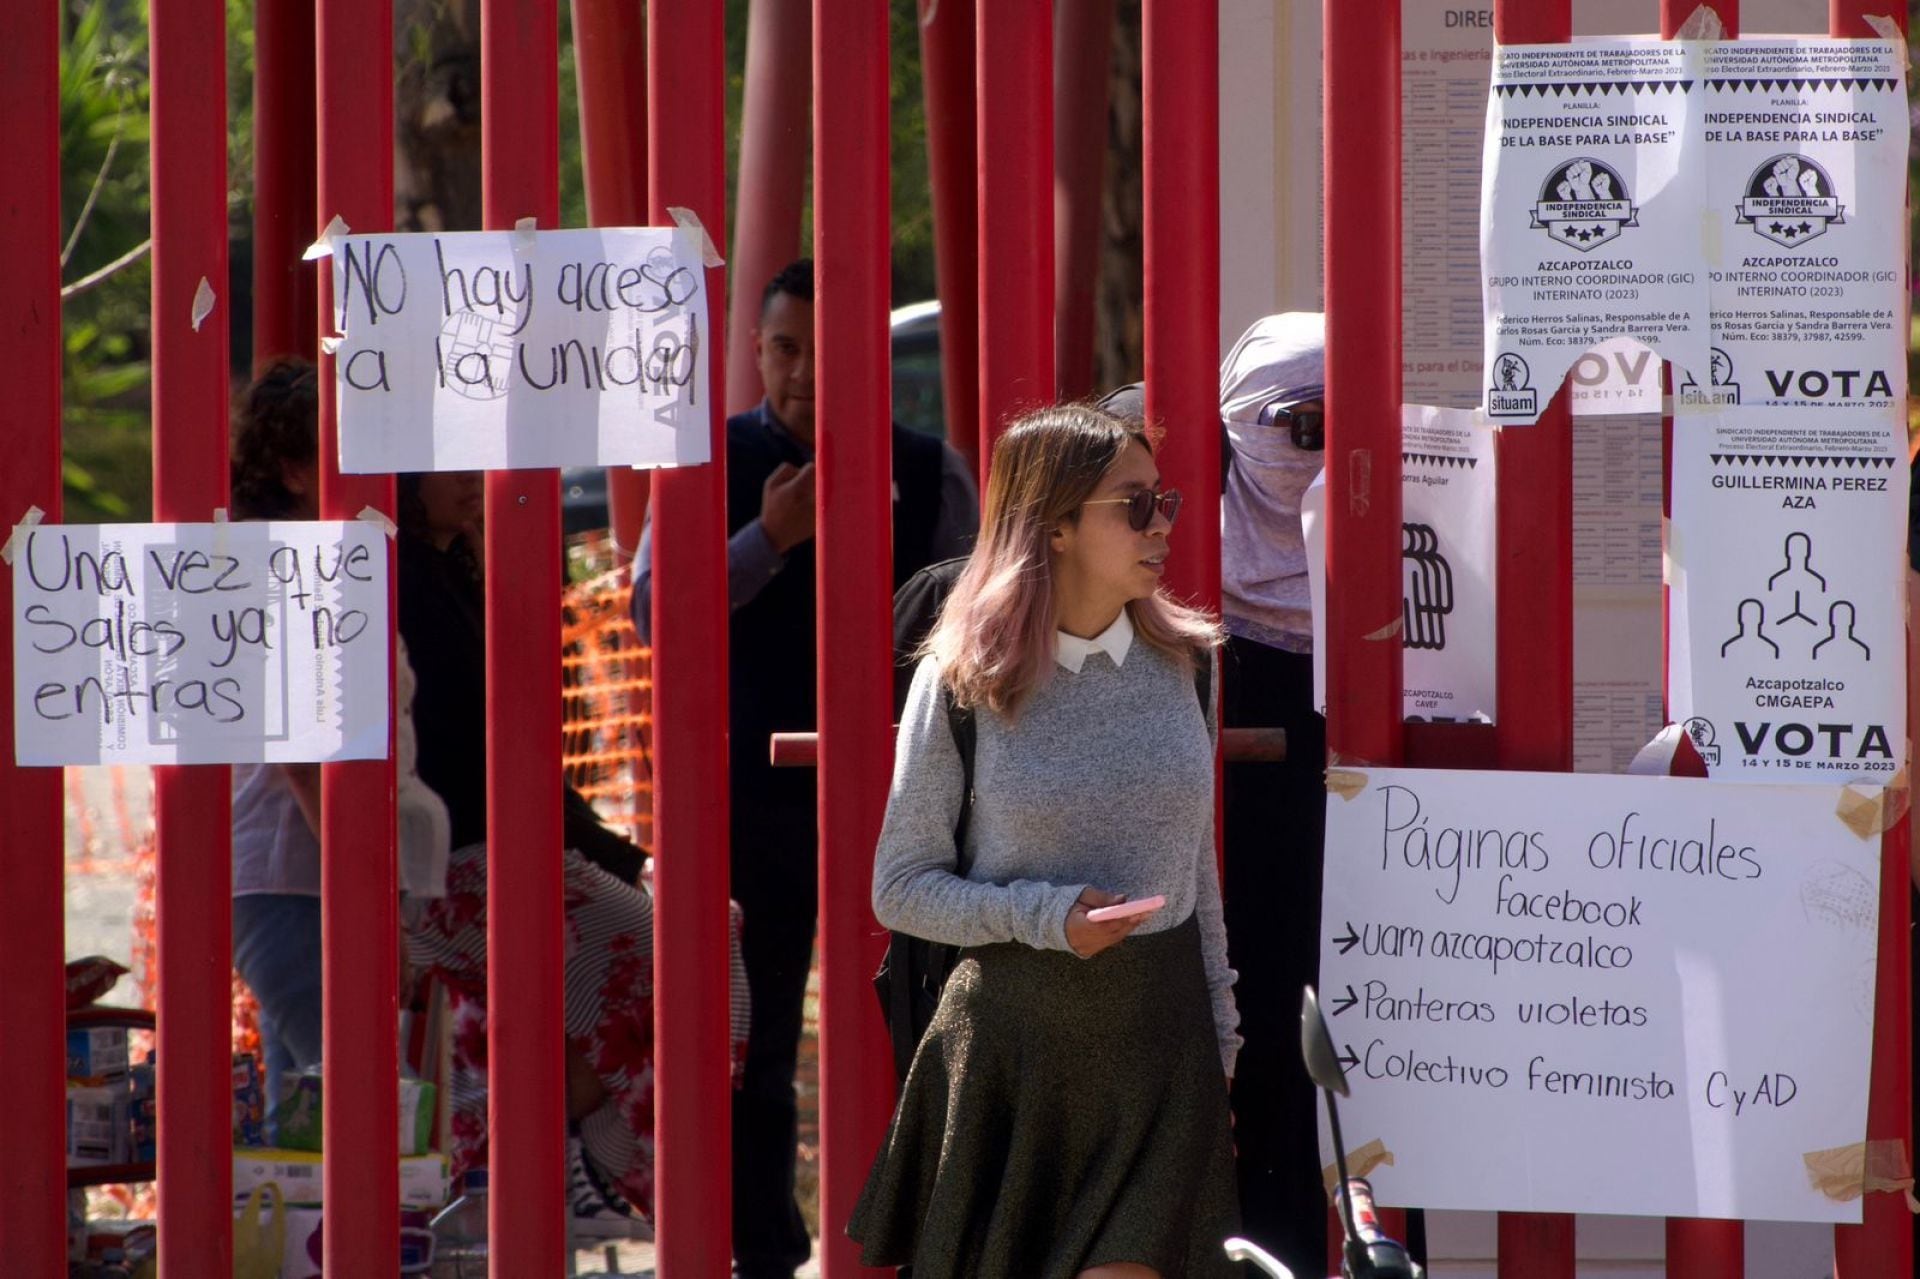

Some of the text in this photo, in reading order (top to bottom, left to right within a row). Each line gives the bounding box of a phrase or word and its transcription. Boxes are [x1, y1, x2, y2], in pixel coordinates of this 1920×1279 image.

[1600, 49, 1659, 58] TRABAJADORES
[1760, 54, 1808, 64] AUTÓNOMA
[1552, 59, 1599, 67] AUTÓNOMA
[1721, 65, 1754, 73] Electoral
[1514, 70, 1546, 78] Electoral
[1607, 68, 1663, 76] Febrero-Marzo
[1607, 115, 1668, 126] SINDICAL
[1705, 113, 1876, 124] INDEPENDENCIA SINDICAL
[1520, 137, 1534, 146] LA
[1539, 135, 1572, 145] BASE
[1576, 135, 1609, 145] PARA
[1614, 134, 1630, 144] LA
[1705, 131, 1722, 141] DE
[1726, 131, 1742, 141] LA
[1746, 131, 1779, 141] BASE
[1784, 131, 1818, 141] PARA
[1823, 130, 1838, 141] LA
[1546, 203, 1622, 211] INDEPENDENCIA
[1752, 199, 1829, 207] INDEPENDENCIA
[1538, 260, 1633, 271] AZCAPOTZALCO
[1742, 258, 1838, 267] AZCAPOTZALCO
[1489, 273, 1694, 287] GRUPO INTERNO COORDINADOR (GIC)
[1726, 272, 1777, 282] INTERNO
[1781, 272, 1868, 282] COORDINADOR
[1873, 271, 1897, 282] (GIC)
[341, 239, 698, 336] NO hay acceso
[1738, 287, 1844, 297] INTERINATO (2023)
[1534, 289, 1639, 300] INTERINATO (2023)
[1532, 312, 1690, 324] Herros Salinas, Responsable de A
[1736, 310, 1893, 321] Herros Salinas, Responsable de A
[1522, 326, 1548, 335] Rosas
[1583, 328, 1589, 336] y
[1592, 324, 1625, 333] Sandra
[1628, 324, 1663, 332] Barrera
[1666, 323, 1690, 332] Vera.
[1725, 322, 1751, 330] Rosas
[1788, 324, 1793, 332] y
[1795, 321, 1829, 330] Sandra
[1832, 322, 1868, 330] Barrera
[1751, 333, 1769, 341] Eco:
[346, 349, 390, 392] a
[436, 336, 495, 399] la
[519, 312, 699, 405] unidad
[1765, 371, 1893, 397] VOTA
[1492, 395, 1532, 411] situam
[1422, 475, 1448, 486] Aguilar
[1712, 475, 1887, 491] GUILLERMINA PEREZ
[1782, 496, 1815, 509] AZA
[27, 531, 134, 595] Una
[151, 550, 251, 593] vez
[270, 544, 372, 610] que
[209, 607, 273, 667] ya
[312, 607, 368, 650] no
[1746, 677, 1844, 692] Azcapotzalco
[34, 667, 244, 724] entras
[1756, 694, 1834, 708] CMGAEPA
[1734, 722, 1893, 758] VOTA
[1742, 759, 1895, 771] 14 Y 15 DE MARZO 2023
[1377, 785, 1762, 903] Páginas oficiales
[1497, 875, 1641, 926] facebook
[1364, 980, 1647, 1027] Panteras violetas
[1364, 1039, 1508, 1088] Colectivo
[1528, 1056, 1674, 1100] feminista
